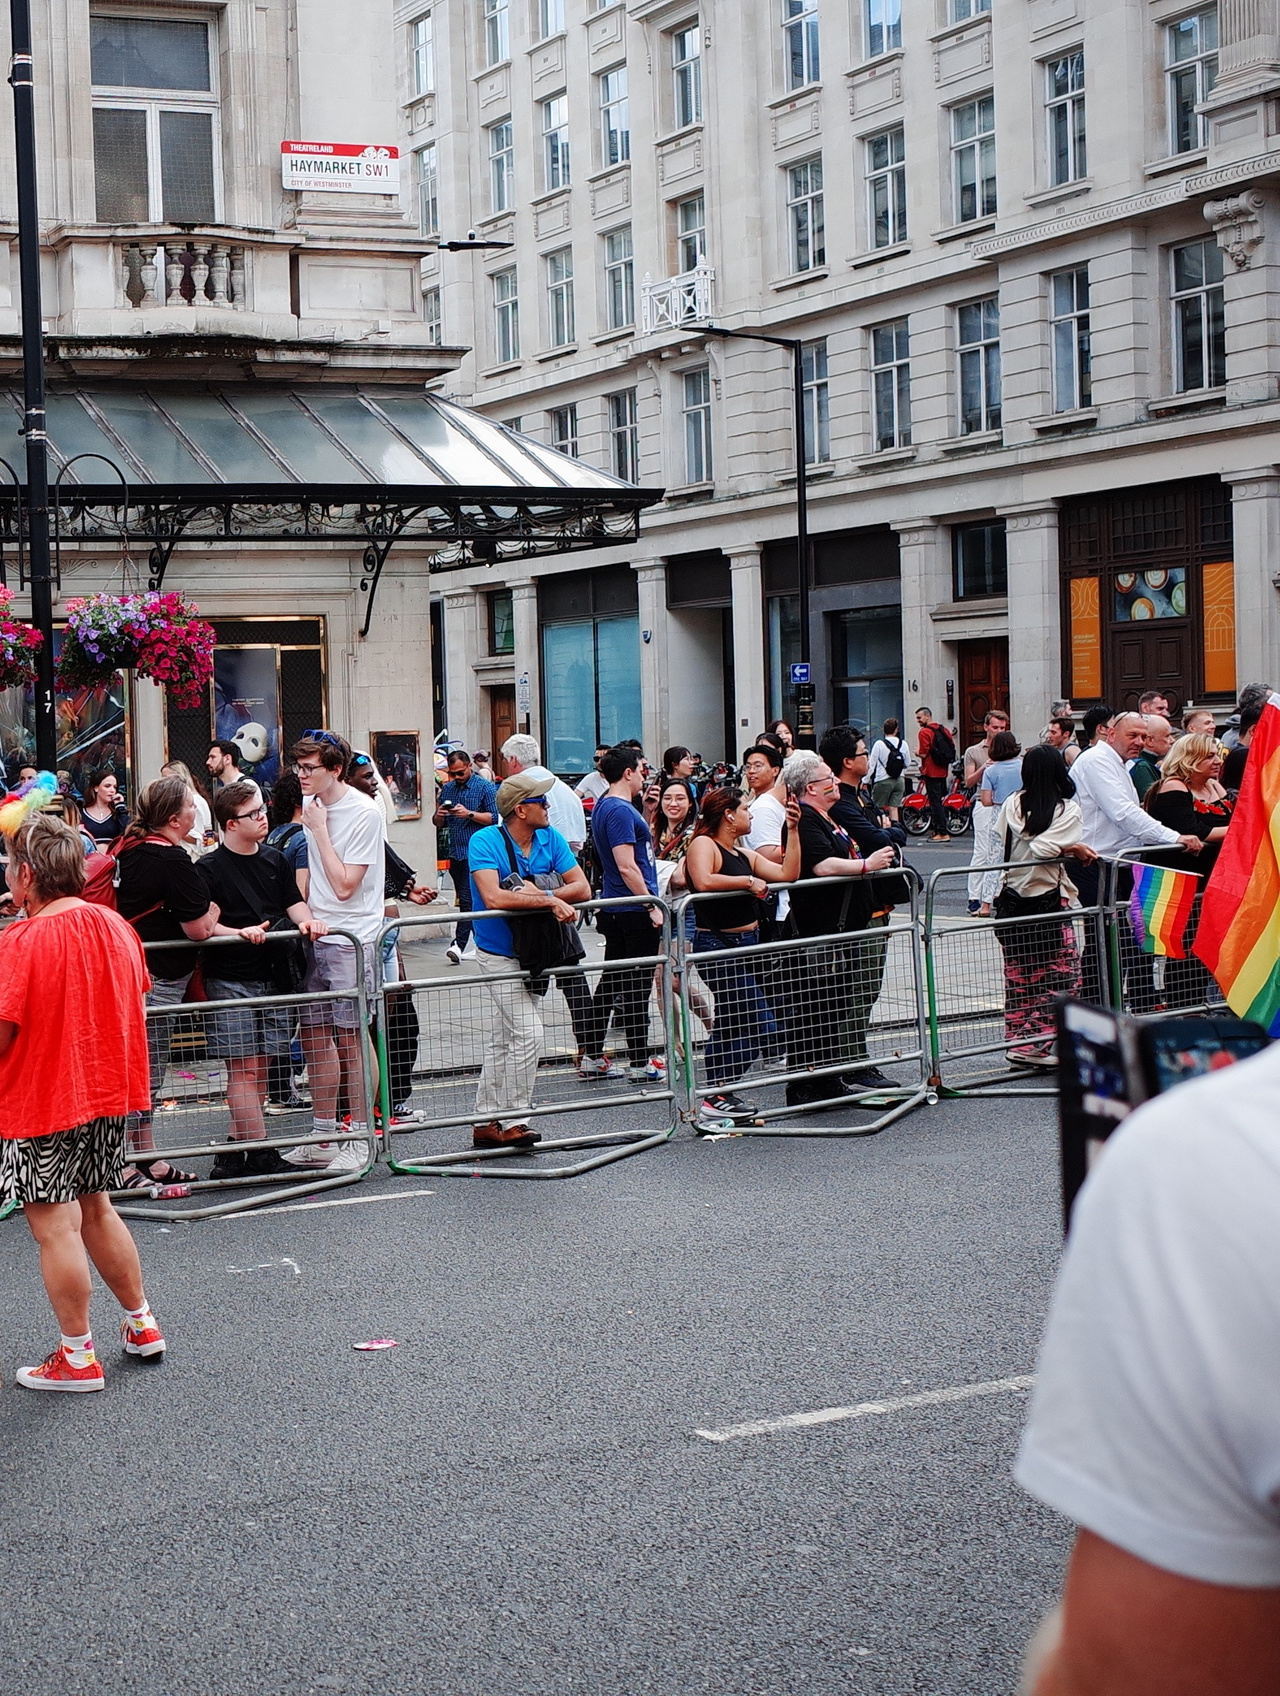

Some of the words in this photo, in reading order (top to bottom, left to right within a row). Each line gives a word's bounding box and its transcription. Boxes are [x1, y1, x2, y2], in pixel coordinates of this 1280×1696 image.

[289, 143, 334, 153] THEATRELAND
[290, 159, 362, 175] HAYMARKET
[365, 163, 389, 177] SW1
[291, 179, 304, 187] CITY
[313, 180, 352, 189] WESTMINSTER
[908, 679, 919, 693] 16
